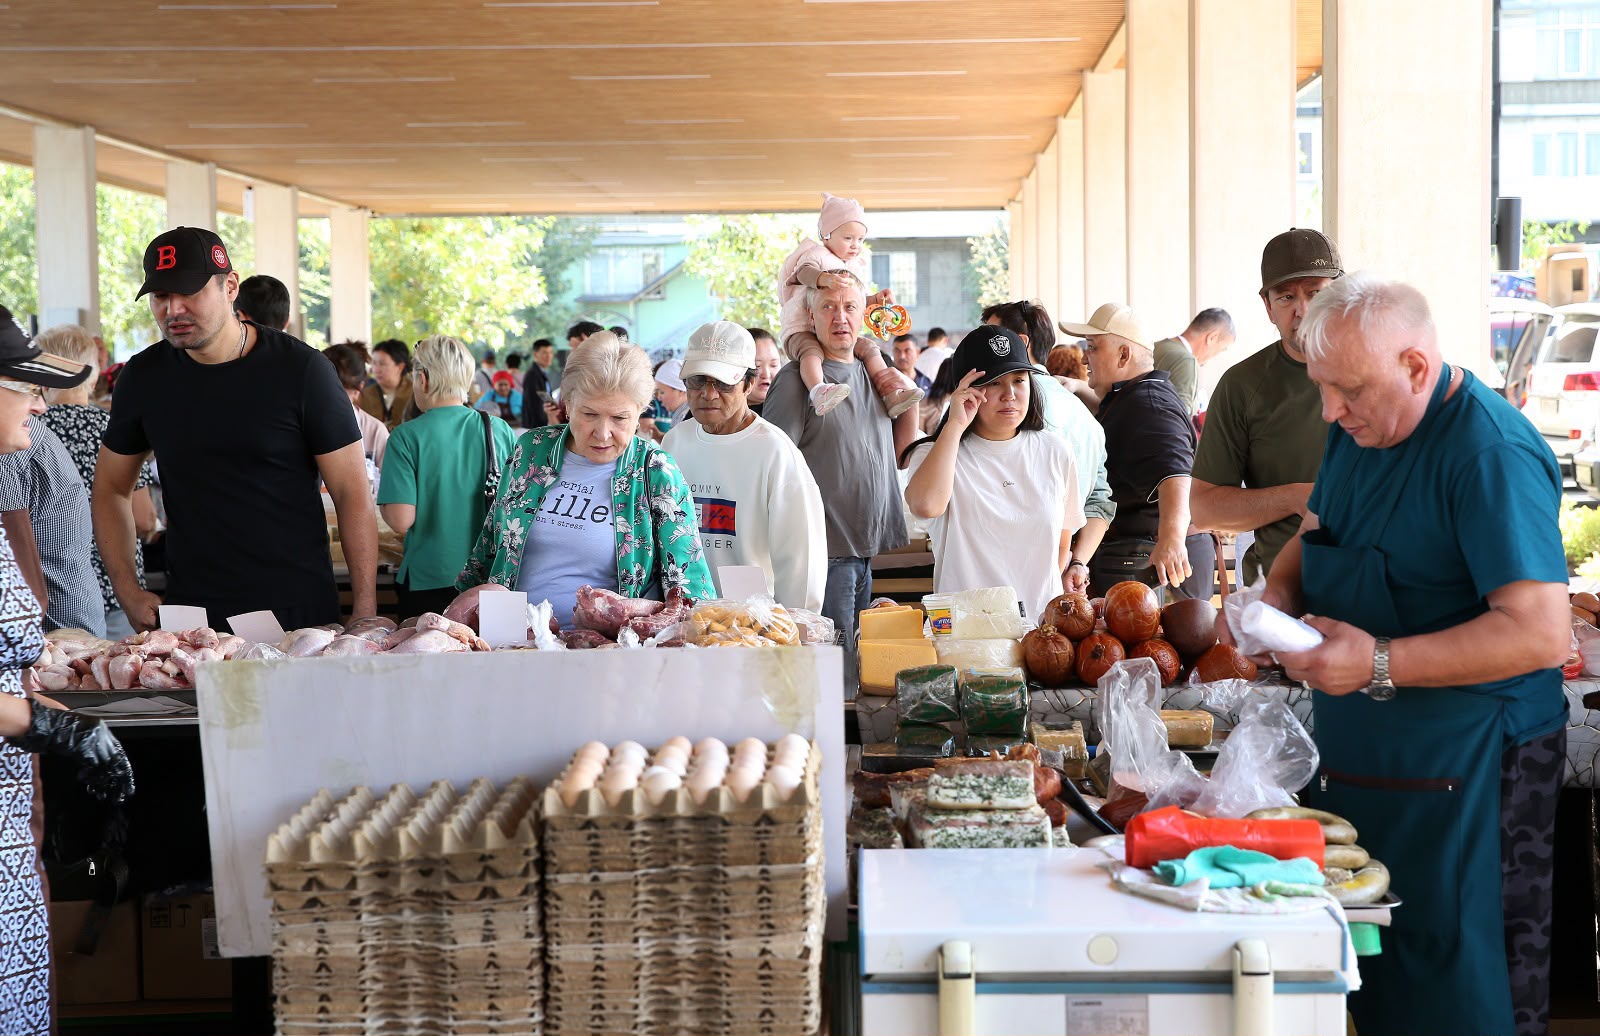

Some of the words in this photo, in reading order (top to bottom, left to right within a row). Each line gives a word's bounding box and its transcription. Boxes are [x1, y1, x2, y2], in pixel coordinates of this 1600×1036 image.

[156, 245, 176, 270] B
[690, 484, 721, 494] OMMY
[557, 520, 587, 531] stress.
